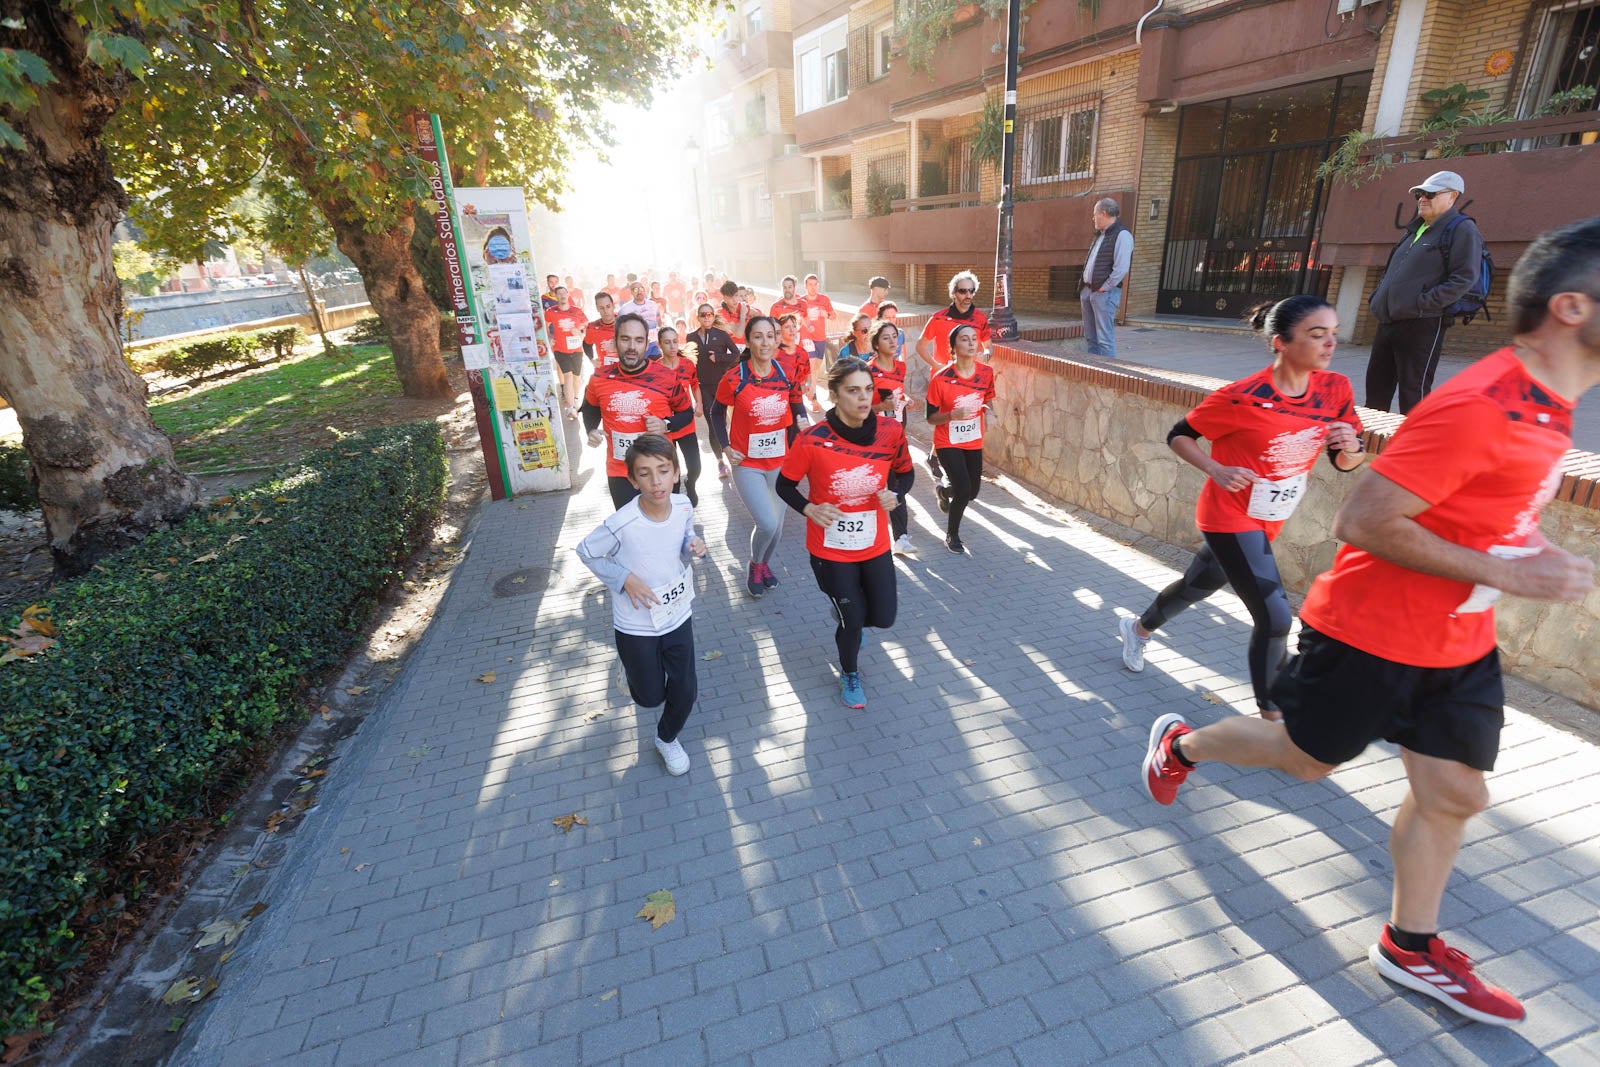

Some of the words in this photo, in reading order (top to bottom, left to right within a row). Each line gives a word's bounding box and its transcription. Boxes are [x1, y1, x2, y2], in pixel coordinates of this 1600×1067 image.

[1269, 128, 1278, 143] 2
[619, 439, 633, 448] 53
[758, 437, 777, 448] 354
[837, 520, 864, 532] 532
[662, 582, 685, 605] 353
